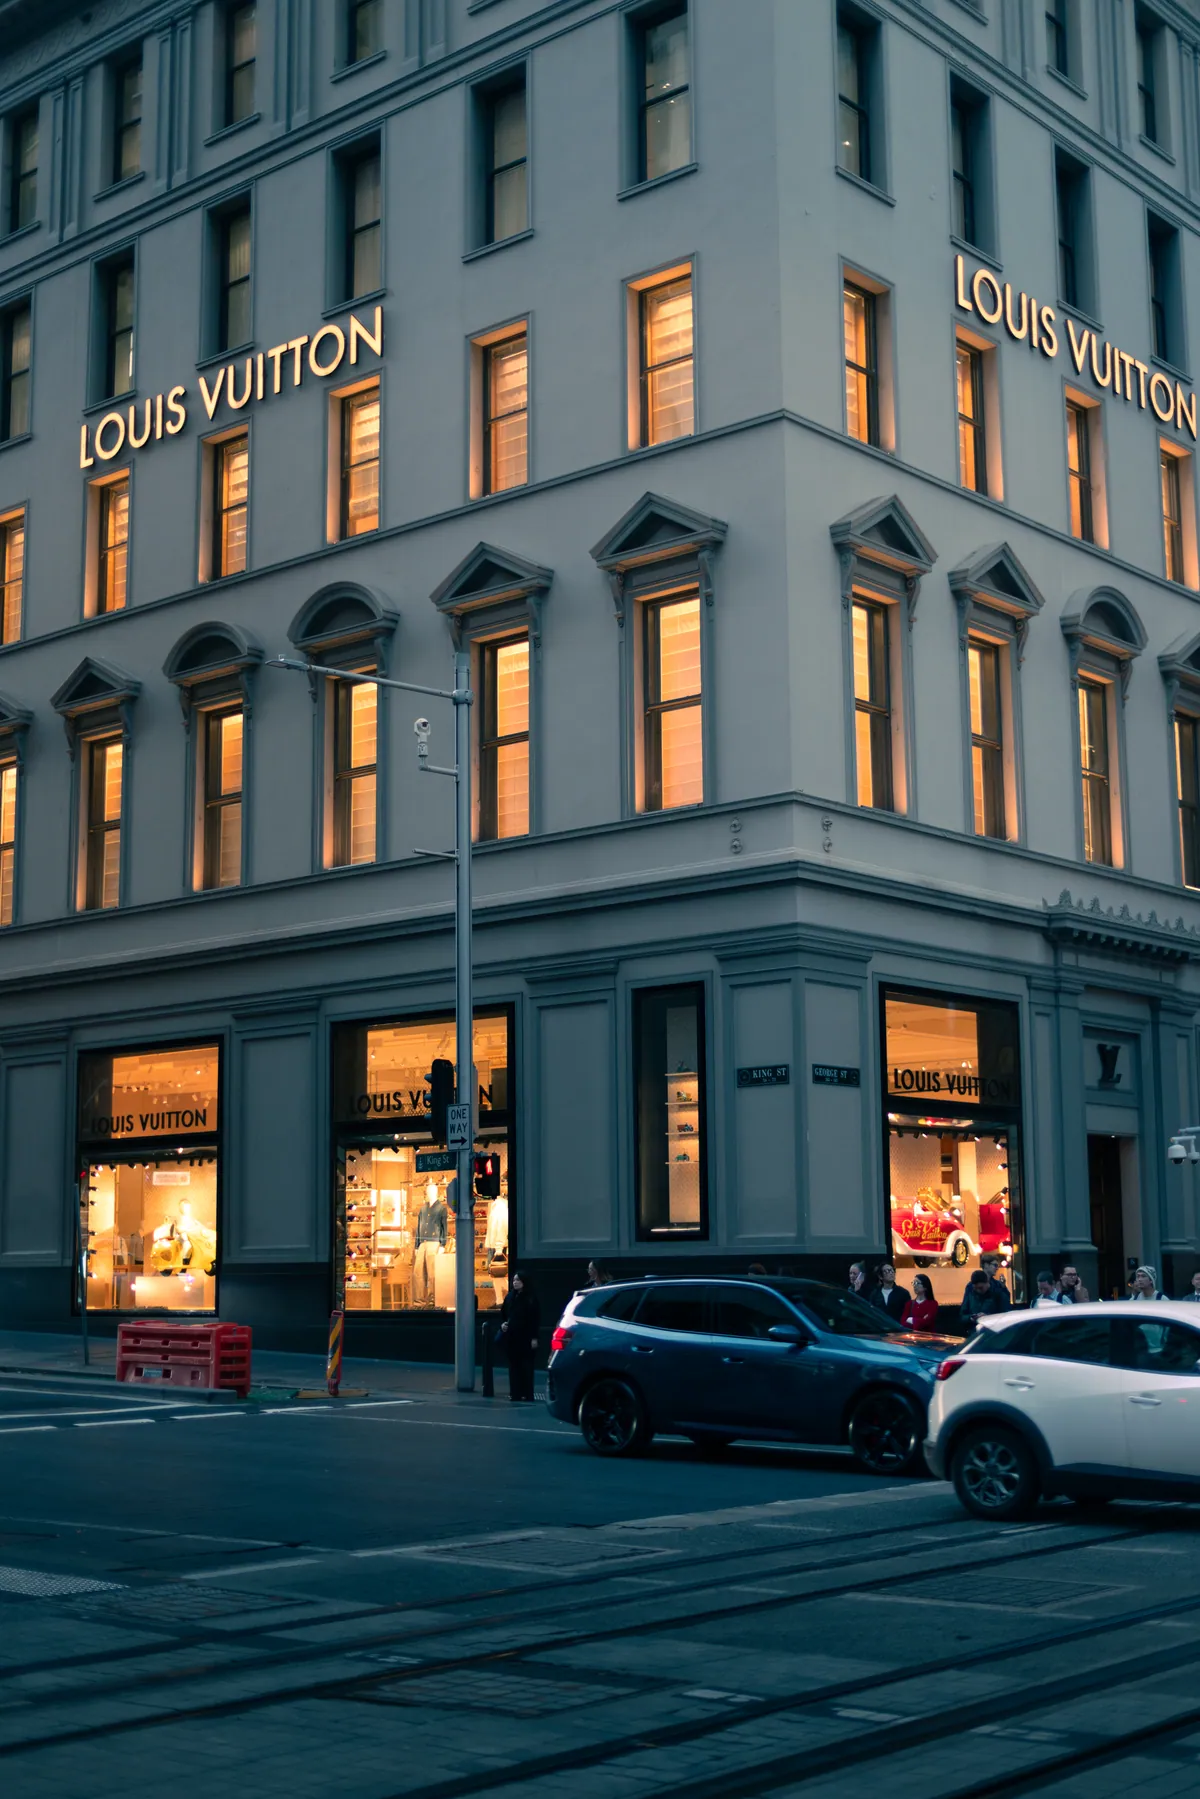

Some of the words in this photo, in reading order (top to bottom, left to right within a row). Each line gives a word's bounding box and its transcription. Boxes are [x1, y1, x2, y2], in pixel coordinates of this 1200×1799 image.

[955, 254, 1059, 358] LOUIS
[1065, 318, 1197, 441] VUITTON
[80, 385, 187, 470] LOUIS
[198, 305, 384, 421] VUITTON
[752, 1068, 772, 1078] KING
[776, 1067, 786, 1076] ST
[814, 1067, 838, 1077] GEORGE
[840, 1070, 848, 1079] ST
[894, 1068, 940, 1092] LOUIS
[139, 1108, 207, 1131] VUITTON
[450, 1108, 467, 1121] ONE
[449, 1122, 468, 1134] WAY
[426, 1155, 442, 1167] King
[442, 1154, 450, 1164] St
